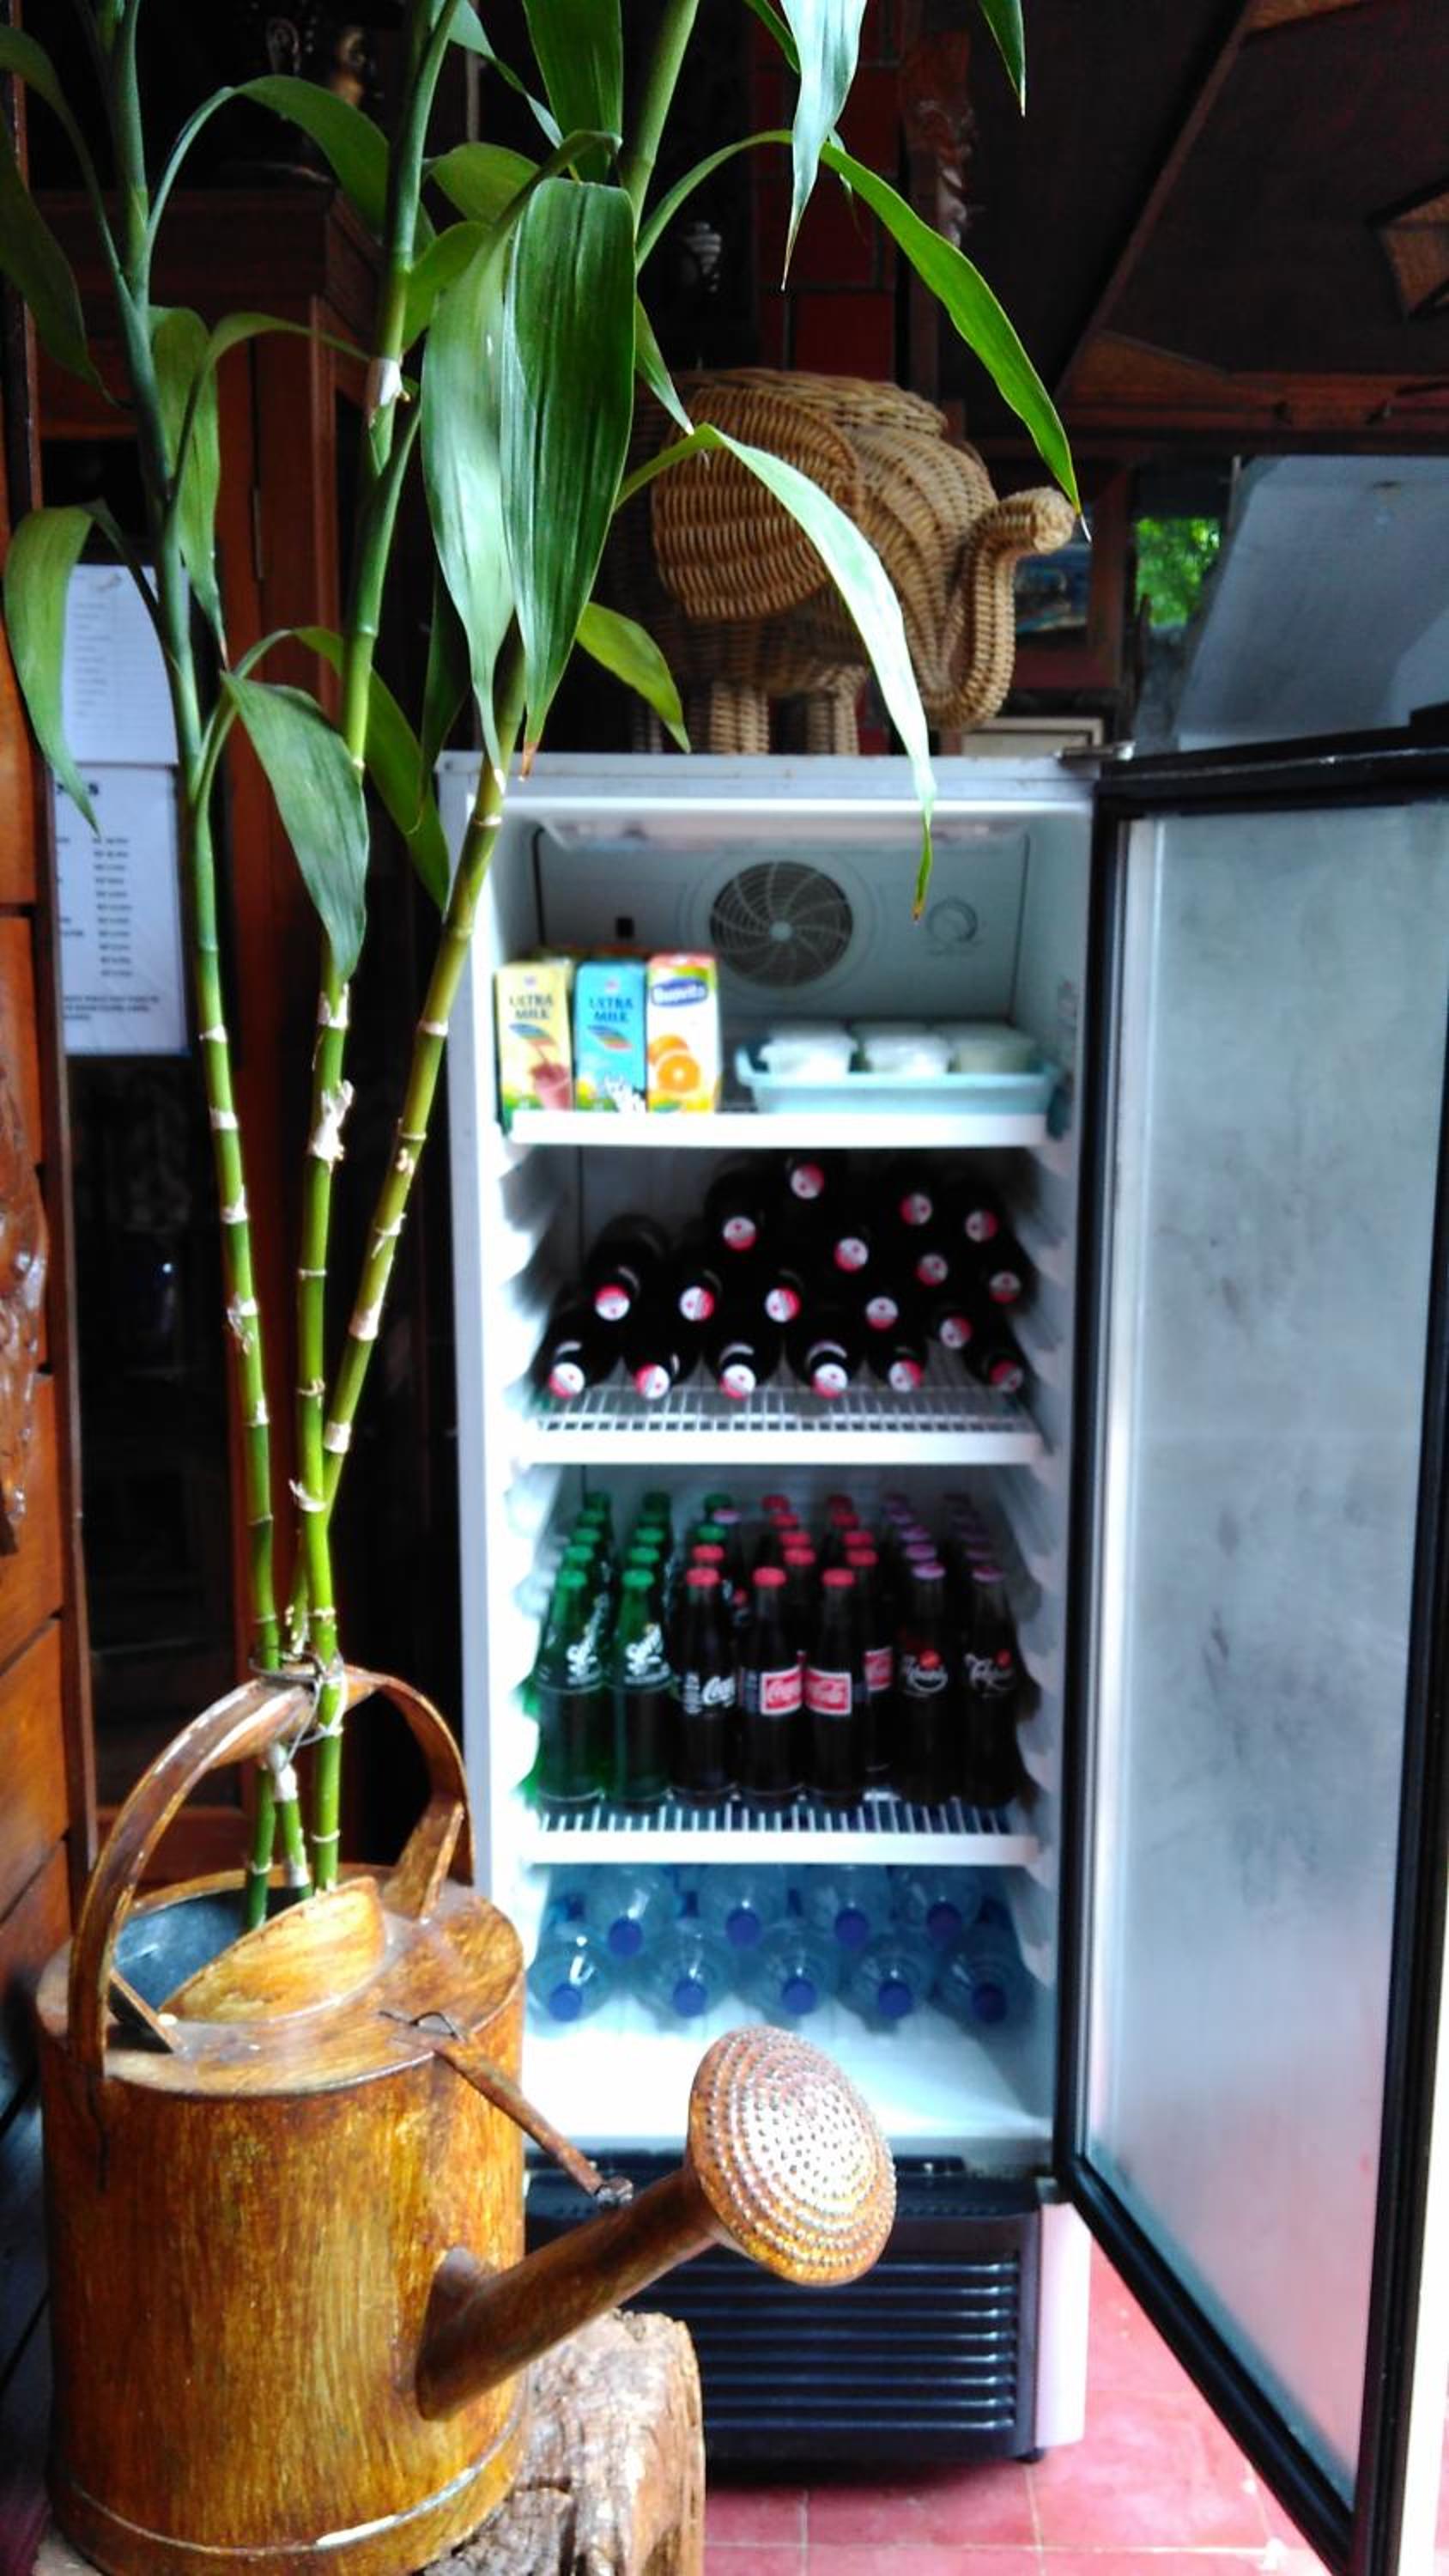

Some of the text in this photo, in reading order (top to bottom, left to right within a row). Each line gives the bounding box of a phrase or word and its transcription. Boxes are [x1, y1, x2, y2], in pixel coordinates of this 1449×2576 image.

[509, 993, 554, 1006] ULTRA
[589, 996, 634, 1010] ULTRA
[515, 1007, 549, 1020] MILK
[593, 1010, 630, 1024] MILK
